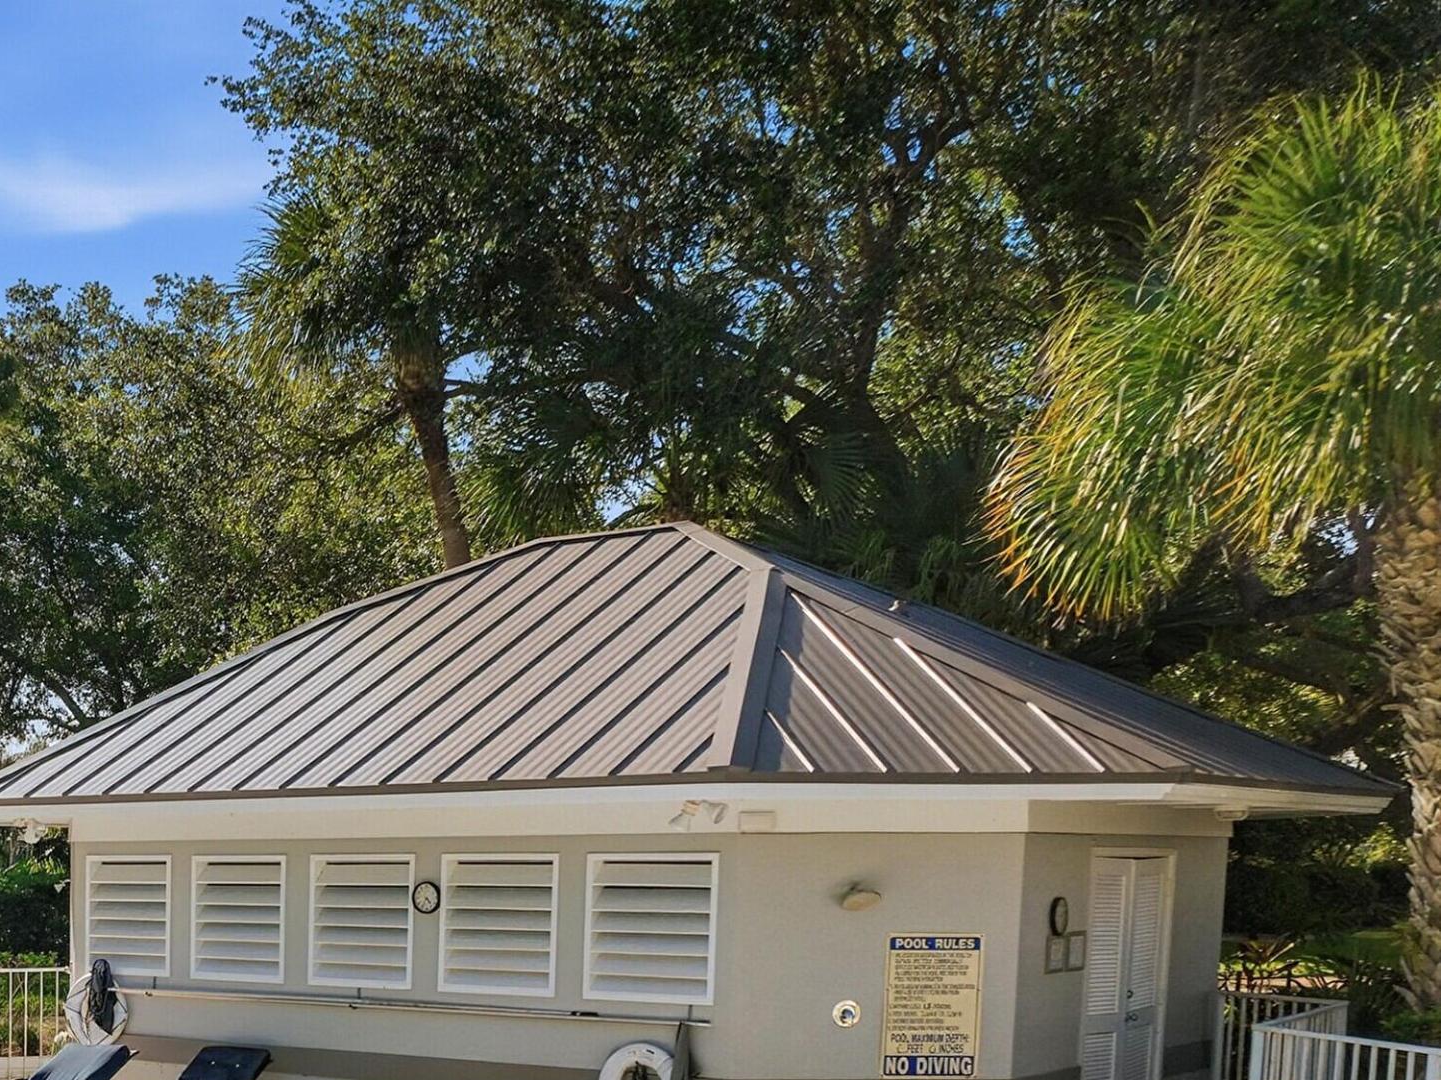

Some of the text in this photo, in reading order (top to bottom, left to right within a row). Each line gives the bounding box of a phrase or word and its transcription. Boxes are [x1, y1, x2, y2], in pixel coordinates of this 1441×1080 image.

[895, 938, 975, 949] POOL RULES
[885, 1057, 973, 1075] NO DIVING
